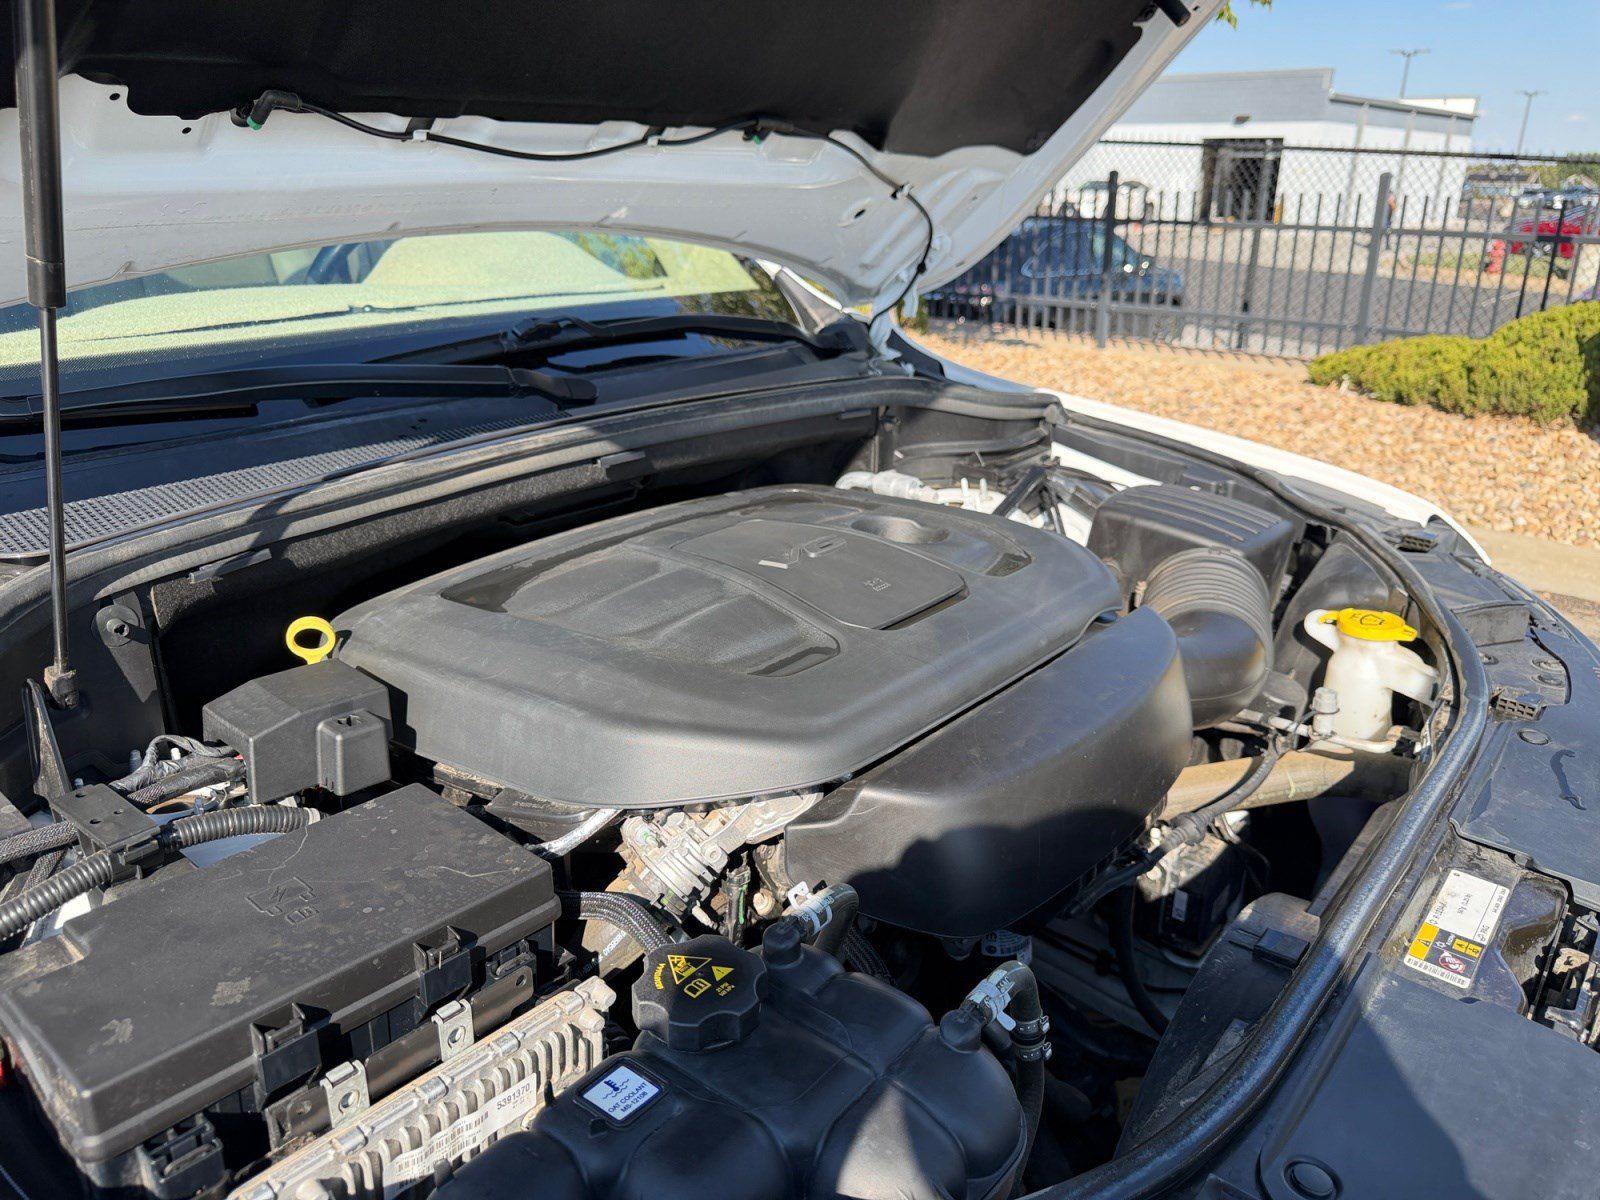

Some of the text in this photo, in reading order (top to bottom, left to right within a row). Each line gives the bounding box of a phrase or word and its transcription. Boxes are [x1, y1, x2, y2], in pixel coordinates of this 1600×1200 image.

[496, 1082, 531, 1110] 5391370
[607, 1082, 647, 1113] OAT COOLANT
